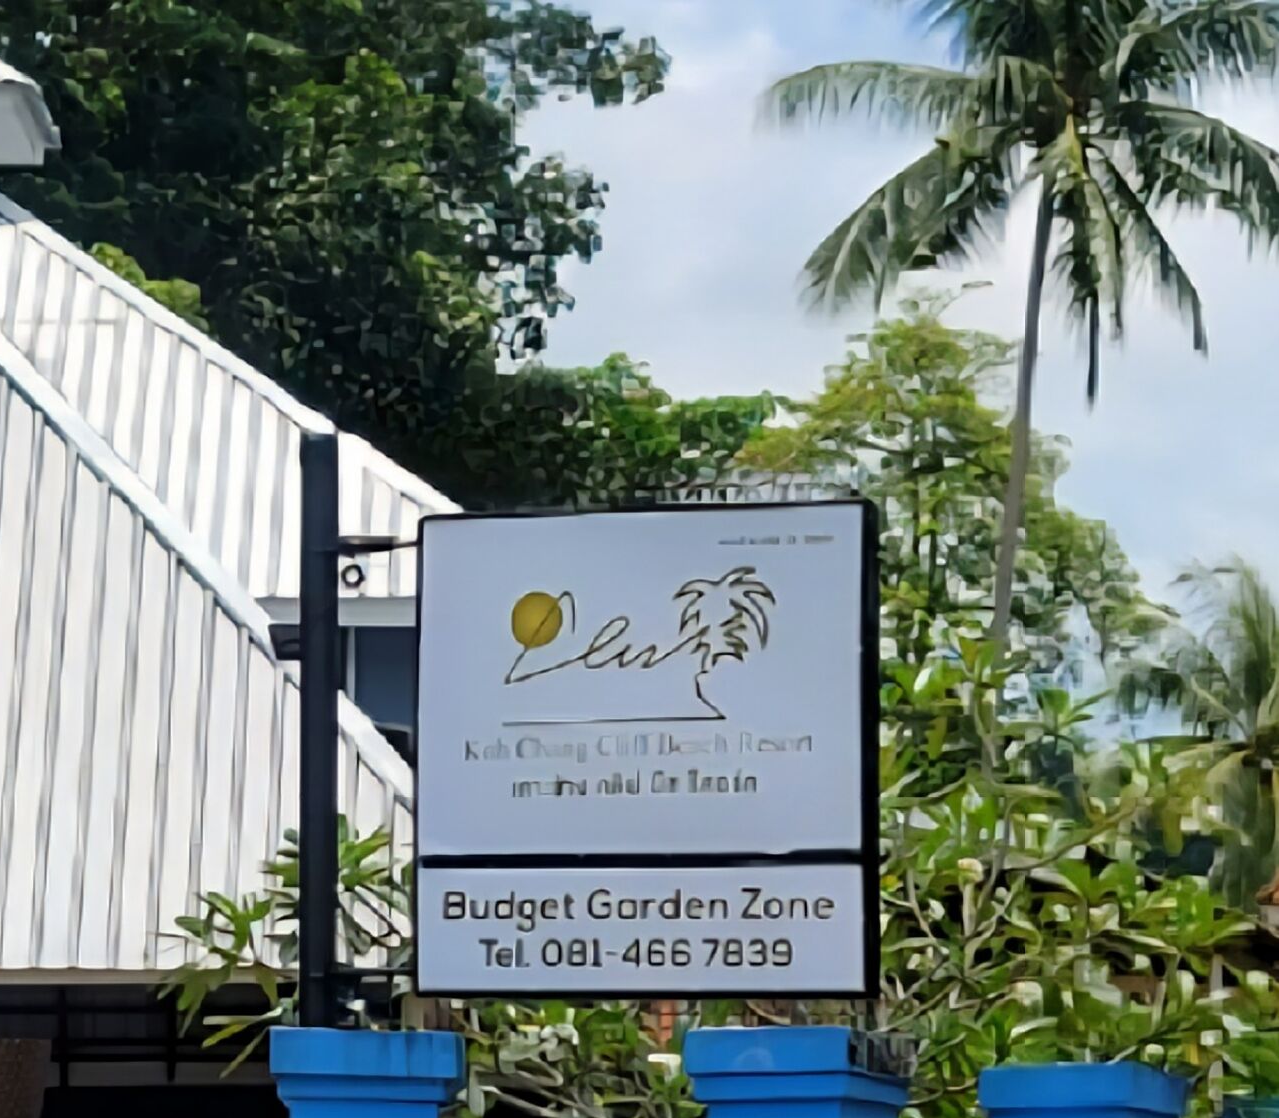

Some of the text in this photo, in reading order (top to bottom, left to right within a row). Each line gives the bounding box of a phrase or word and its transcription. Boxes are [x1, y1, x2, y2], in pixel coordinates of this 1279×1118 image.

[442, 887, 835, 932] Budget Garden Zone
[479, 938, 530, 968] Tel.
